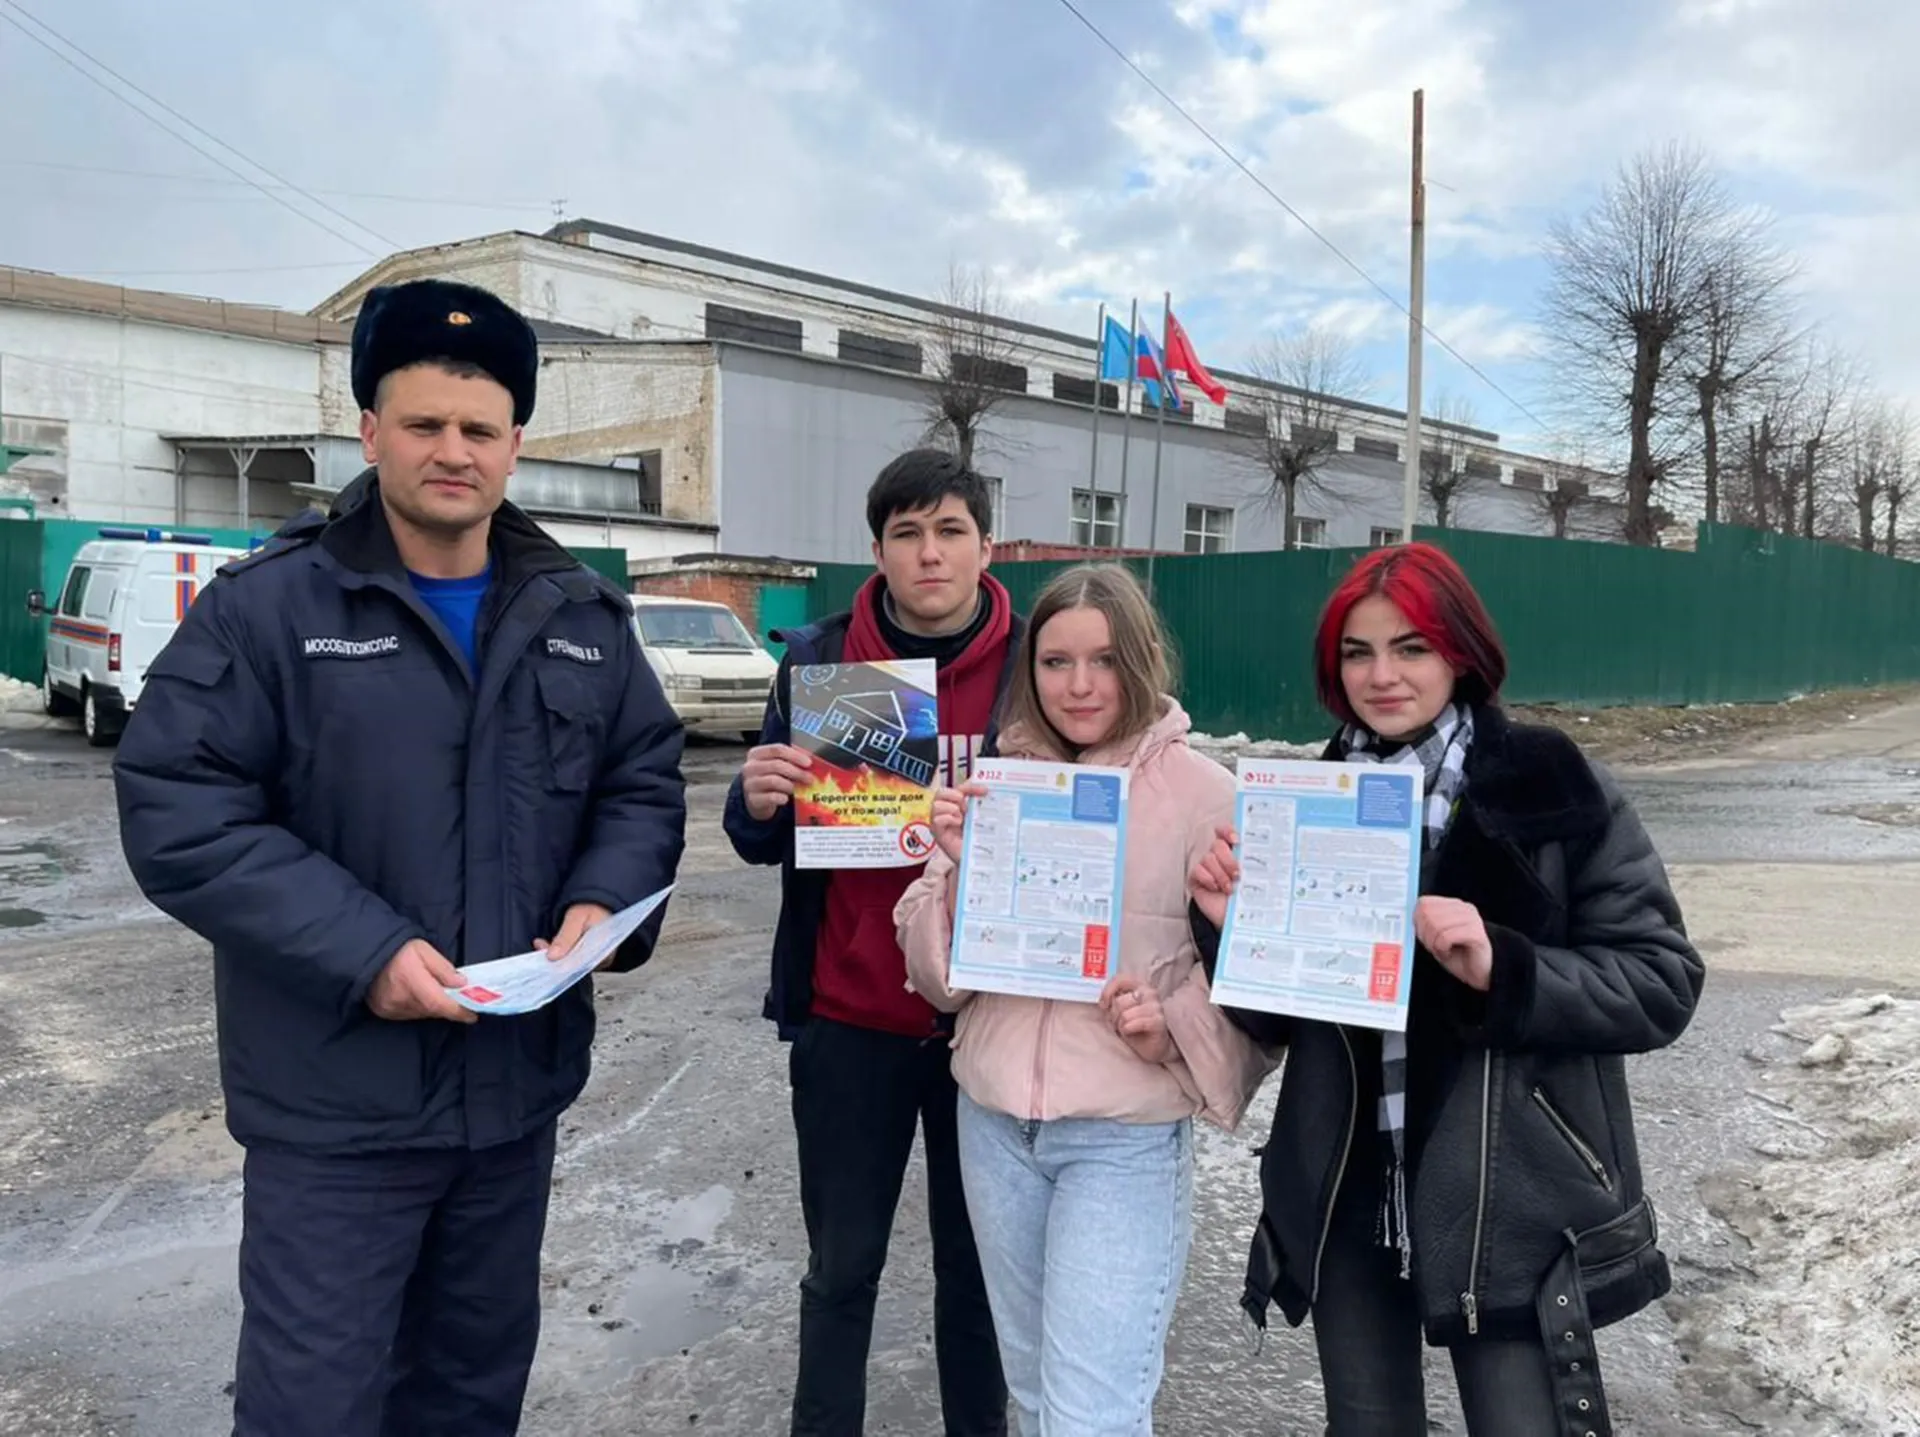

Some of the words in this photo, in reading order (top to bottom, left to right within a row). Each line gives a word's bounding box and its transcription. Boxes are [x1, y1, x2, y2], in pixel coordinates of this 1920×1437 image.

[305, 636, 398, 655] МОСОБЛПОЖСПАС
[1256, 772, 1276, 785] 112
[812, 793, 869, 803] Берегите
[871, 794, 897, 802] ваш
[899, 793, 924, 802] дом
[834, 807, 849, 816] от
[851, 805, 902, 816] пожара!
